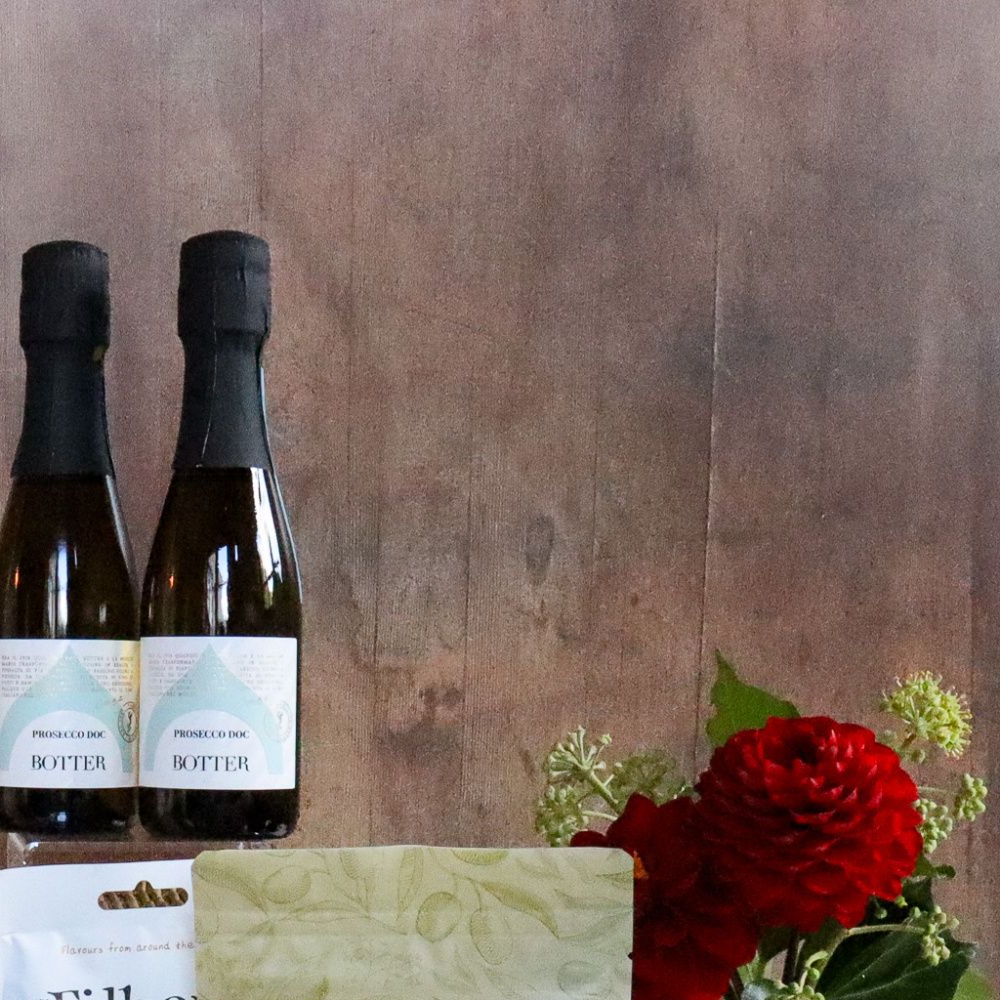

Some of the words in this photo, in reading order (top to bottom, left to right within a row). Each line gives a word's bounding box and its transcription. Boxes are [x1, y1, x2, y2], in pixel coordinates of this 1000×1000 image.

[32, 729, 85, 740] PROSECCO
[86, 729, 107, 740] DOC
[173, 728, 226, 739] PROSECCO
[228, 729, 250, 740] DOC
[31, 754, 106, 772] BOTTER
[172, 754, 250, 773] BOTTER
[108, 941, 132, 953] from
[136, 942, 170, 952] around
[175, 939, 196, 950] the
